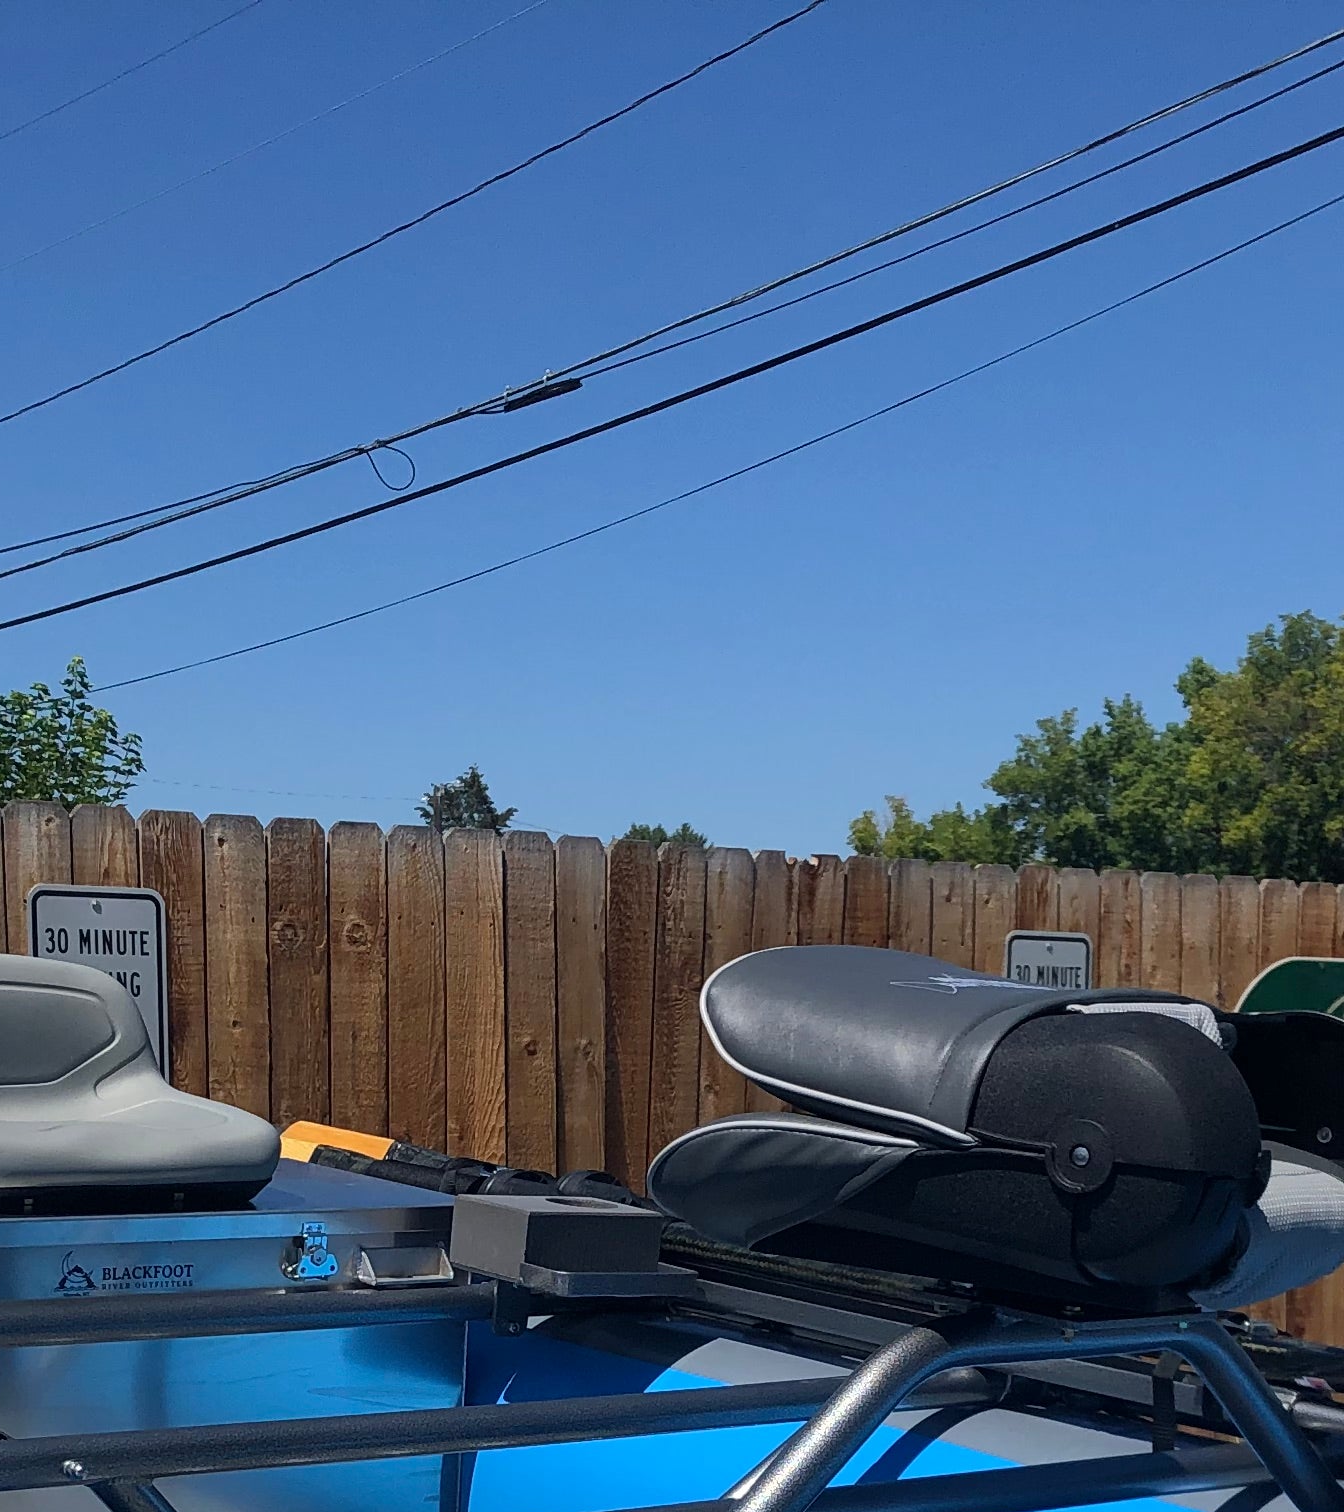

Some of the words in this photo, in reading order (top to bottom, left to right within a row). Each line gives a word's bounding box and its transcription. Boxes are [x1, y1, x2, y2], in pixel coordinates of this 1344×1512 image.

[44, 927, 69, 954] 30
[79, 928, 150, 956] MINUTE
[1015, 964, 1031, 982] 30
[1036, 965, 1082, 988] MINUTE
[102, 1264, 194, 1281] BLACKFOOT
[102, 1282, 130, 1290] RIVER
[134, 1280, 194, 1289] OUTFITTERS
